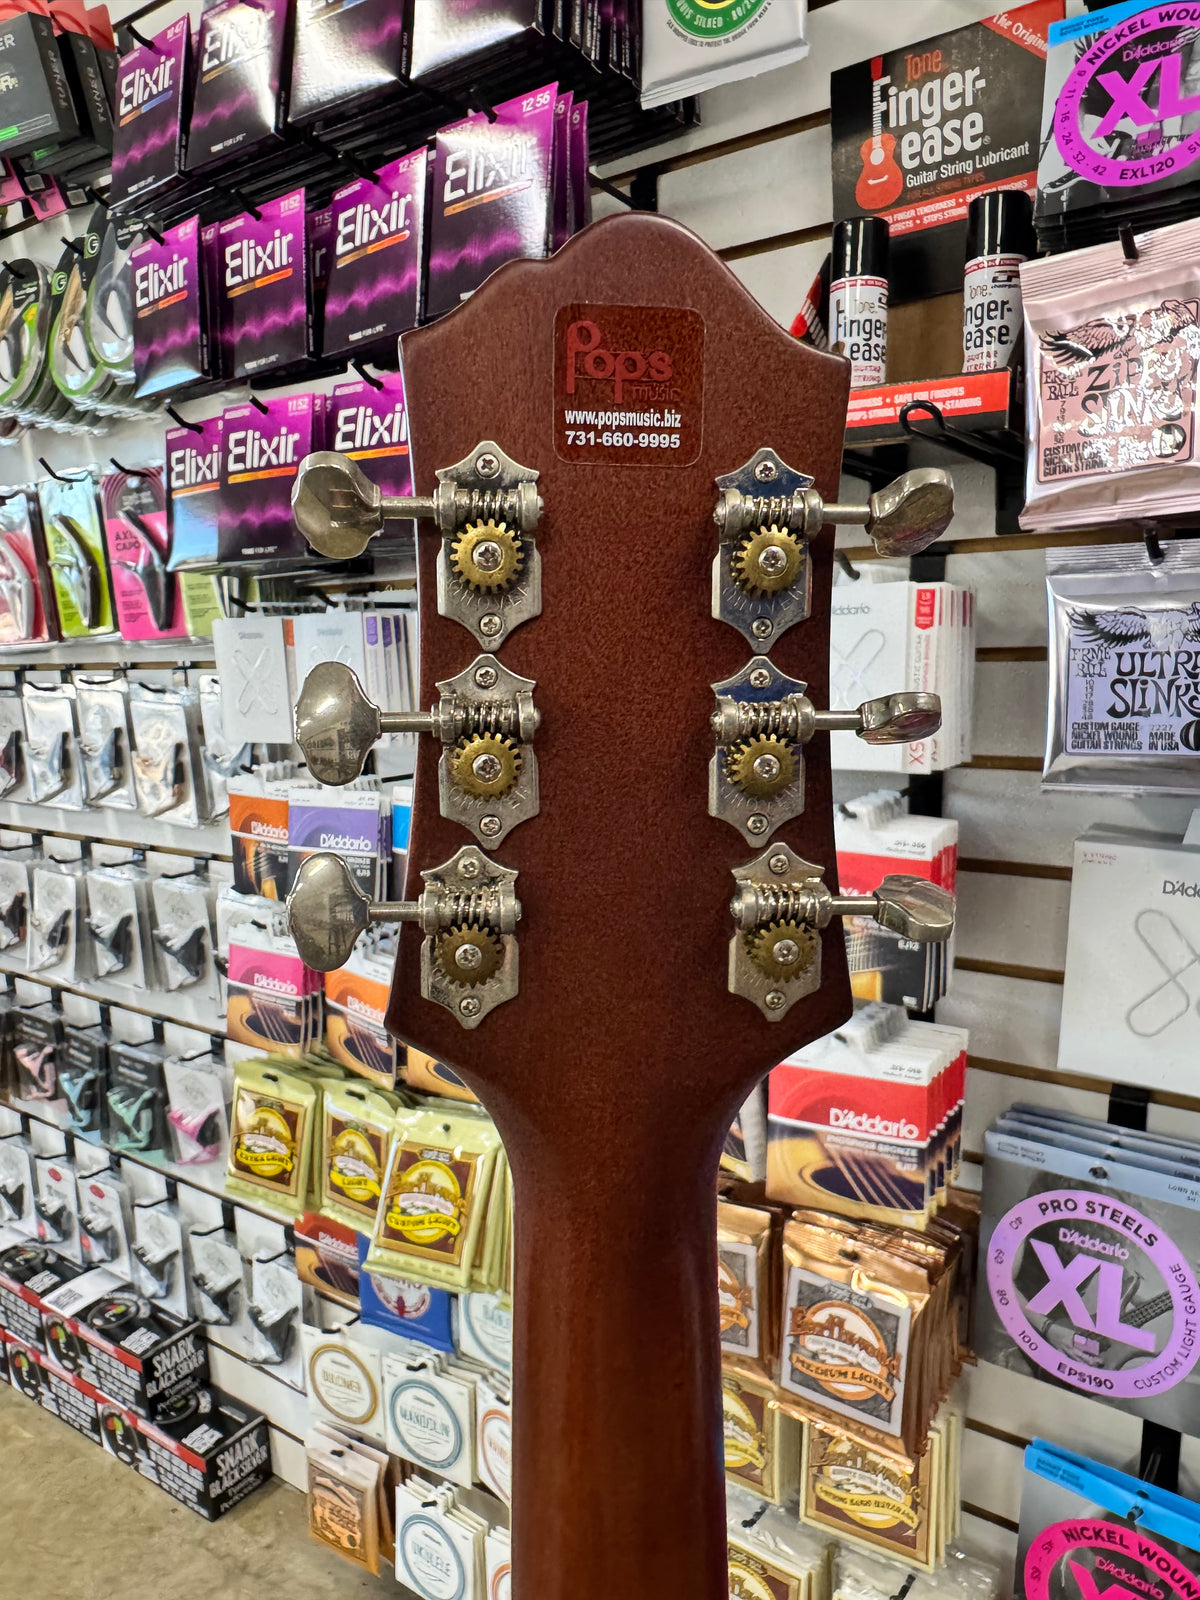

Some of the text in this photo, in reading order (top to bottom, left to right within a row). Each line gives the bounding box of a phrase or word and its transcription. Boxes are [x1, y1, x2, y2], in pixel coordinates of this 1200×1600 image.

[1087, 18, 1151, 66] NICKEL
[120, 56, 176, 116] Elixir
[905, 50, 942, 81] Tone
[901, 112, 984, 169] ease
[1062, 133, 1073, 146] 24
[1073, 152, 1086, 164] 32
[1092, 165, 1107, 176] 42
[906, 141, 1030, 188] Guitar String Lubricant
[1119, 157, 1175, 180] EXL120
[336, 190, 412, 255] Elixir
[226, 229, 293, 287] Elixir
[135, 254, 188, 308] Elixir
[965, 325, 1010, 350] ease
[565, 408, 682, 430] www.popsmusic.biz
[565, 431, 681, 448] 731-660-9995
[228, 427, 300, 473] Elixir
[1071, 722, 1109, 731] CUSTOM
[1111, 722, 1140, 731] GAUGE
[1071, 740, 1101, 750] GUITAR
[1104, 740, 1143, 751] STRINGS
[1160, 741, 1180, 751] USA
[1104, 731, 1138, 741] WOUND
[1149, 732, 1176, 742] MADE
[320, 834, 372, 851] D'Addario
[829, 1107, 919, 1139] D'Addario
[1038, 1197, 1158, 1248] PRO STEELS
[1058, 1227, 1129, 1260] D'Addario
[1025, 1238, 1156, 1353] XL
[1019, 1329, 1039, 1352] 100
[1134, 1263, 1197, 1390] CUSTOM LIGHT GAUGE
[152, 1332, 195, 1378] SNARK
[216, 1429, 260, 1478] SNARK
[1062, 1526, 1130, 1550] NICKEL
